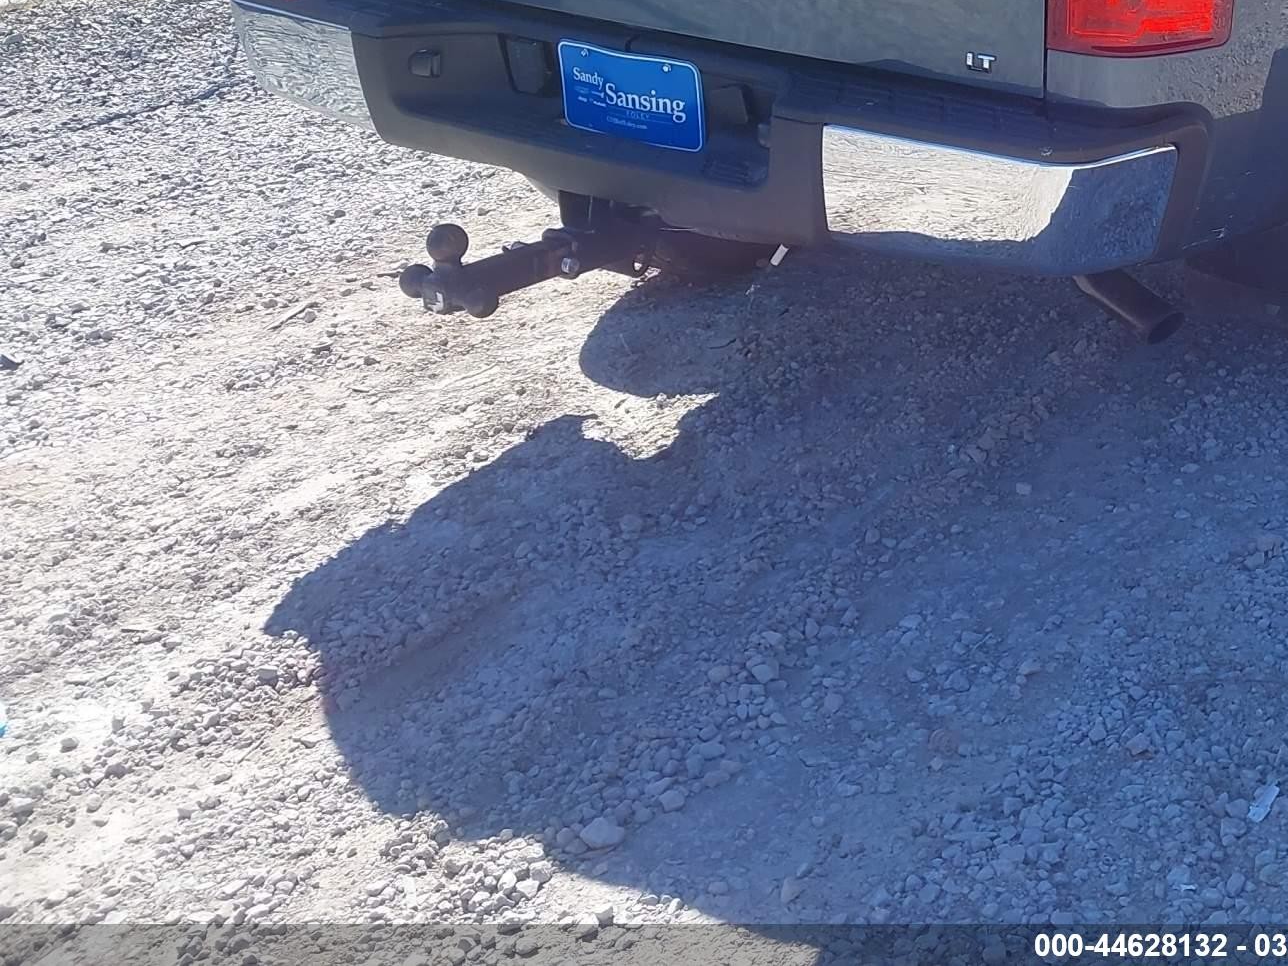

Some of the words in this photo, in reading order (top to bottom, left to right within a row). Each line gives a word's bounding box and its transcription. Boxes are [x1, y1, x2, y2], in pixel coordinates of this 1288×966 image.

[966, 51, 997, 74] LT
[572, 66, 604, 91] Sandy
[605, 82, 687, 124] Sansing
